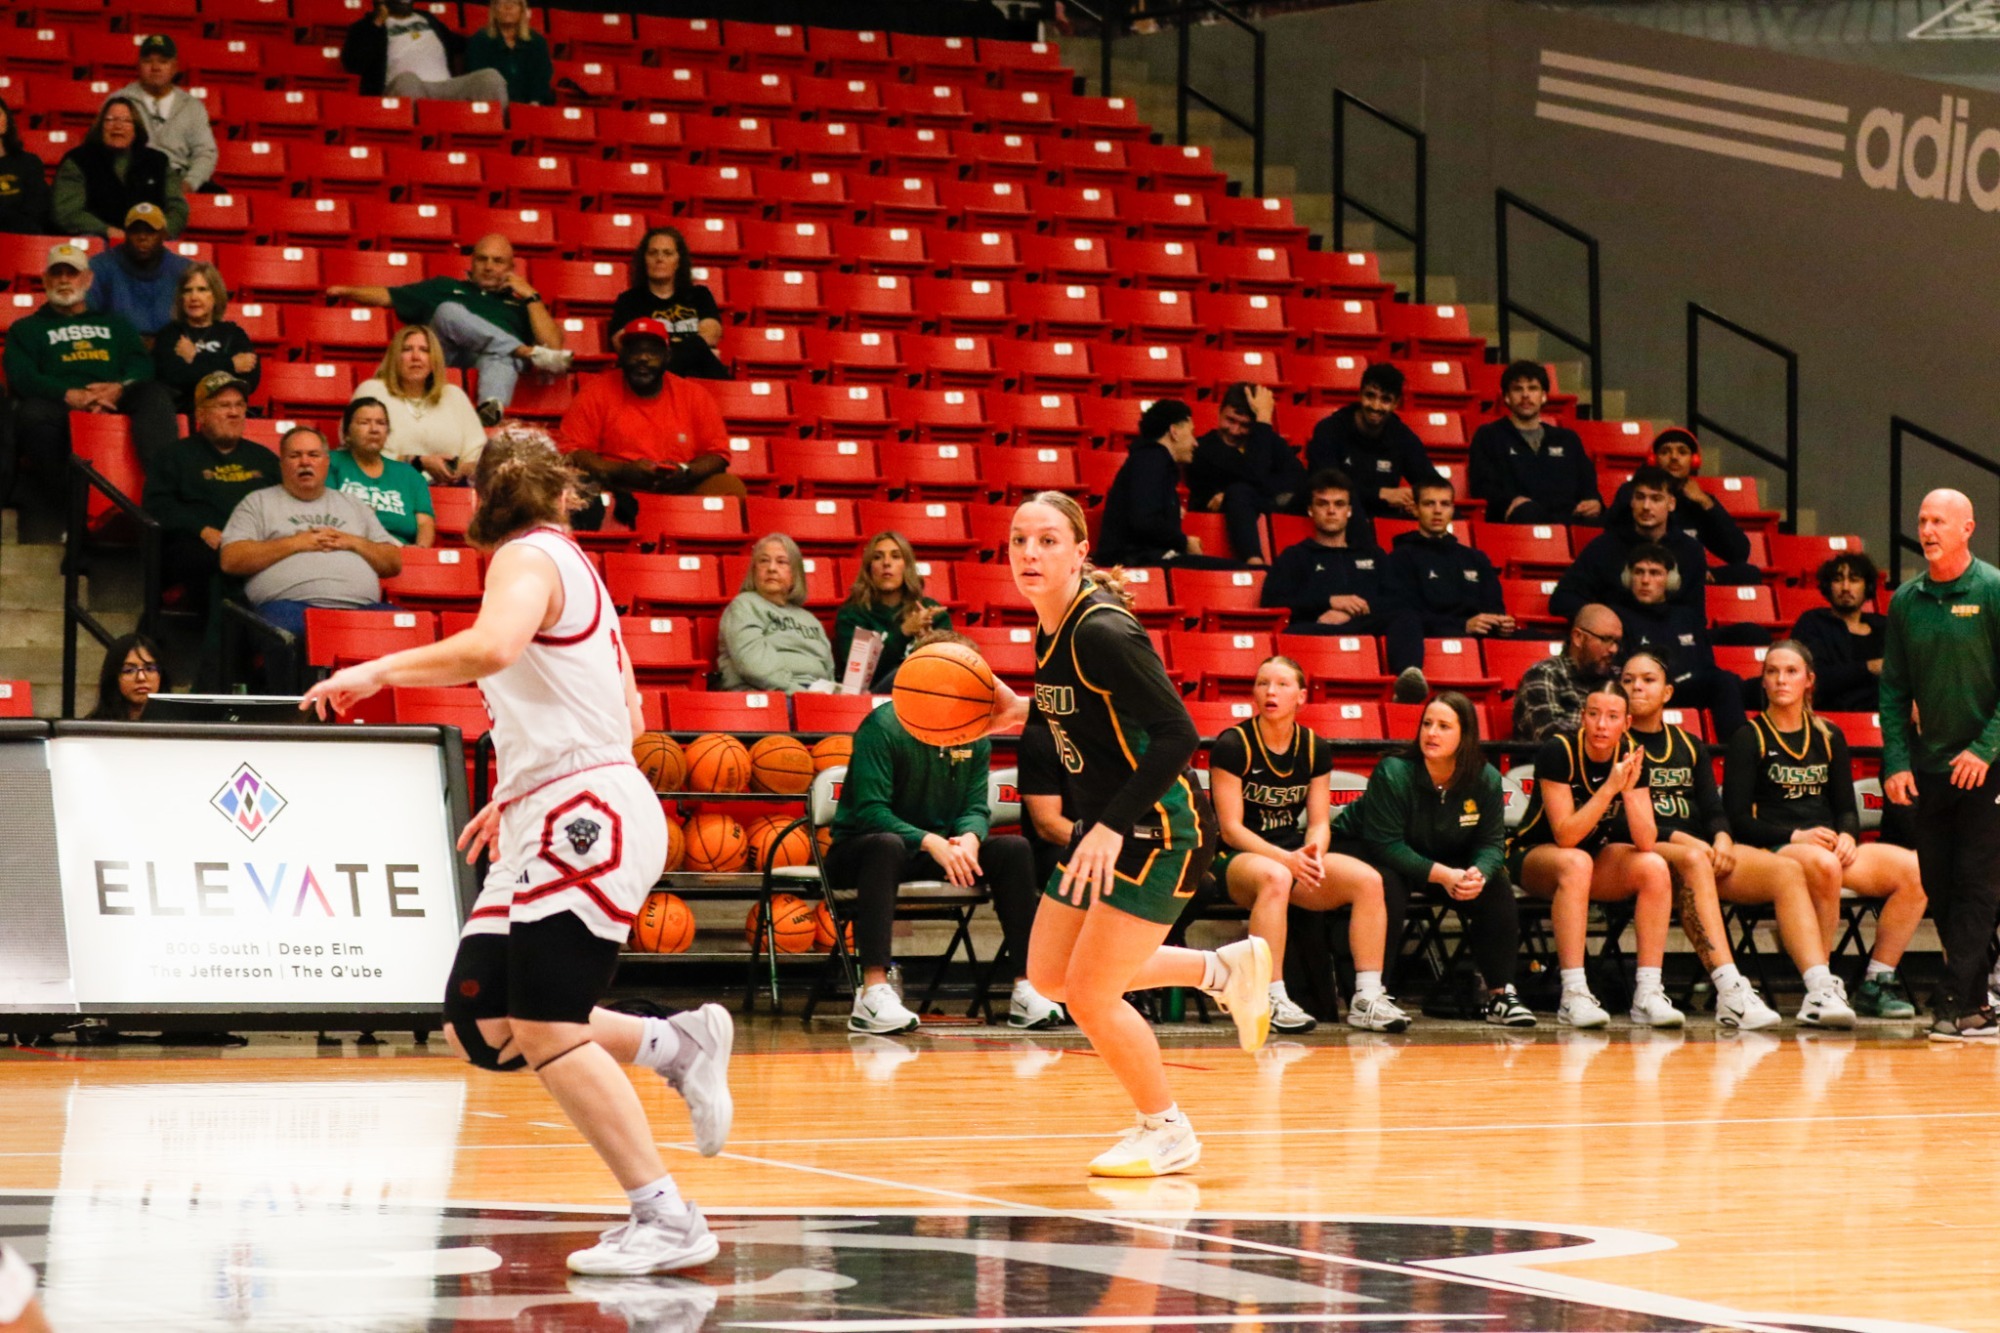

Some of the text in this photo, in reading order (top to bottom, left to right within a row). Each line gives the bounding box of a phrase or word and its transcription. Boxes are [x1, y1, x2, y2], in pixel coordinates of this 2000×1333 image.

[47, 325, 112, 345] MSSU
[1047, 719, 1085, 774] 15
[94, 859, 427, 918] ELEVATE
[165, 942, 365, 958] 800 South Deep Elm
[150, 964, 384, 979] The Jefferson The Q'ube
